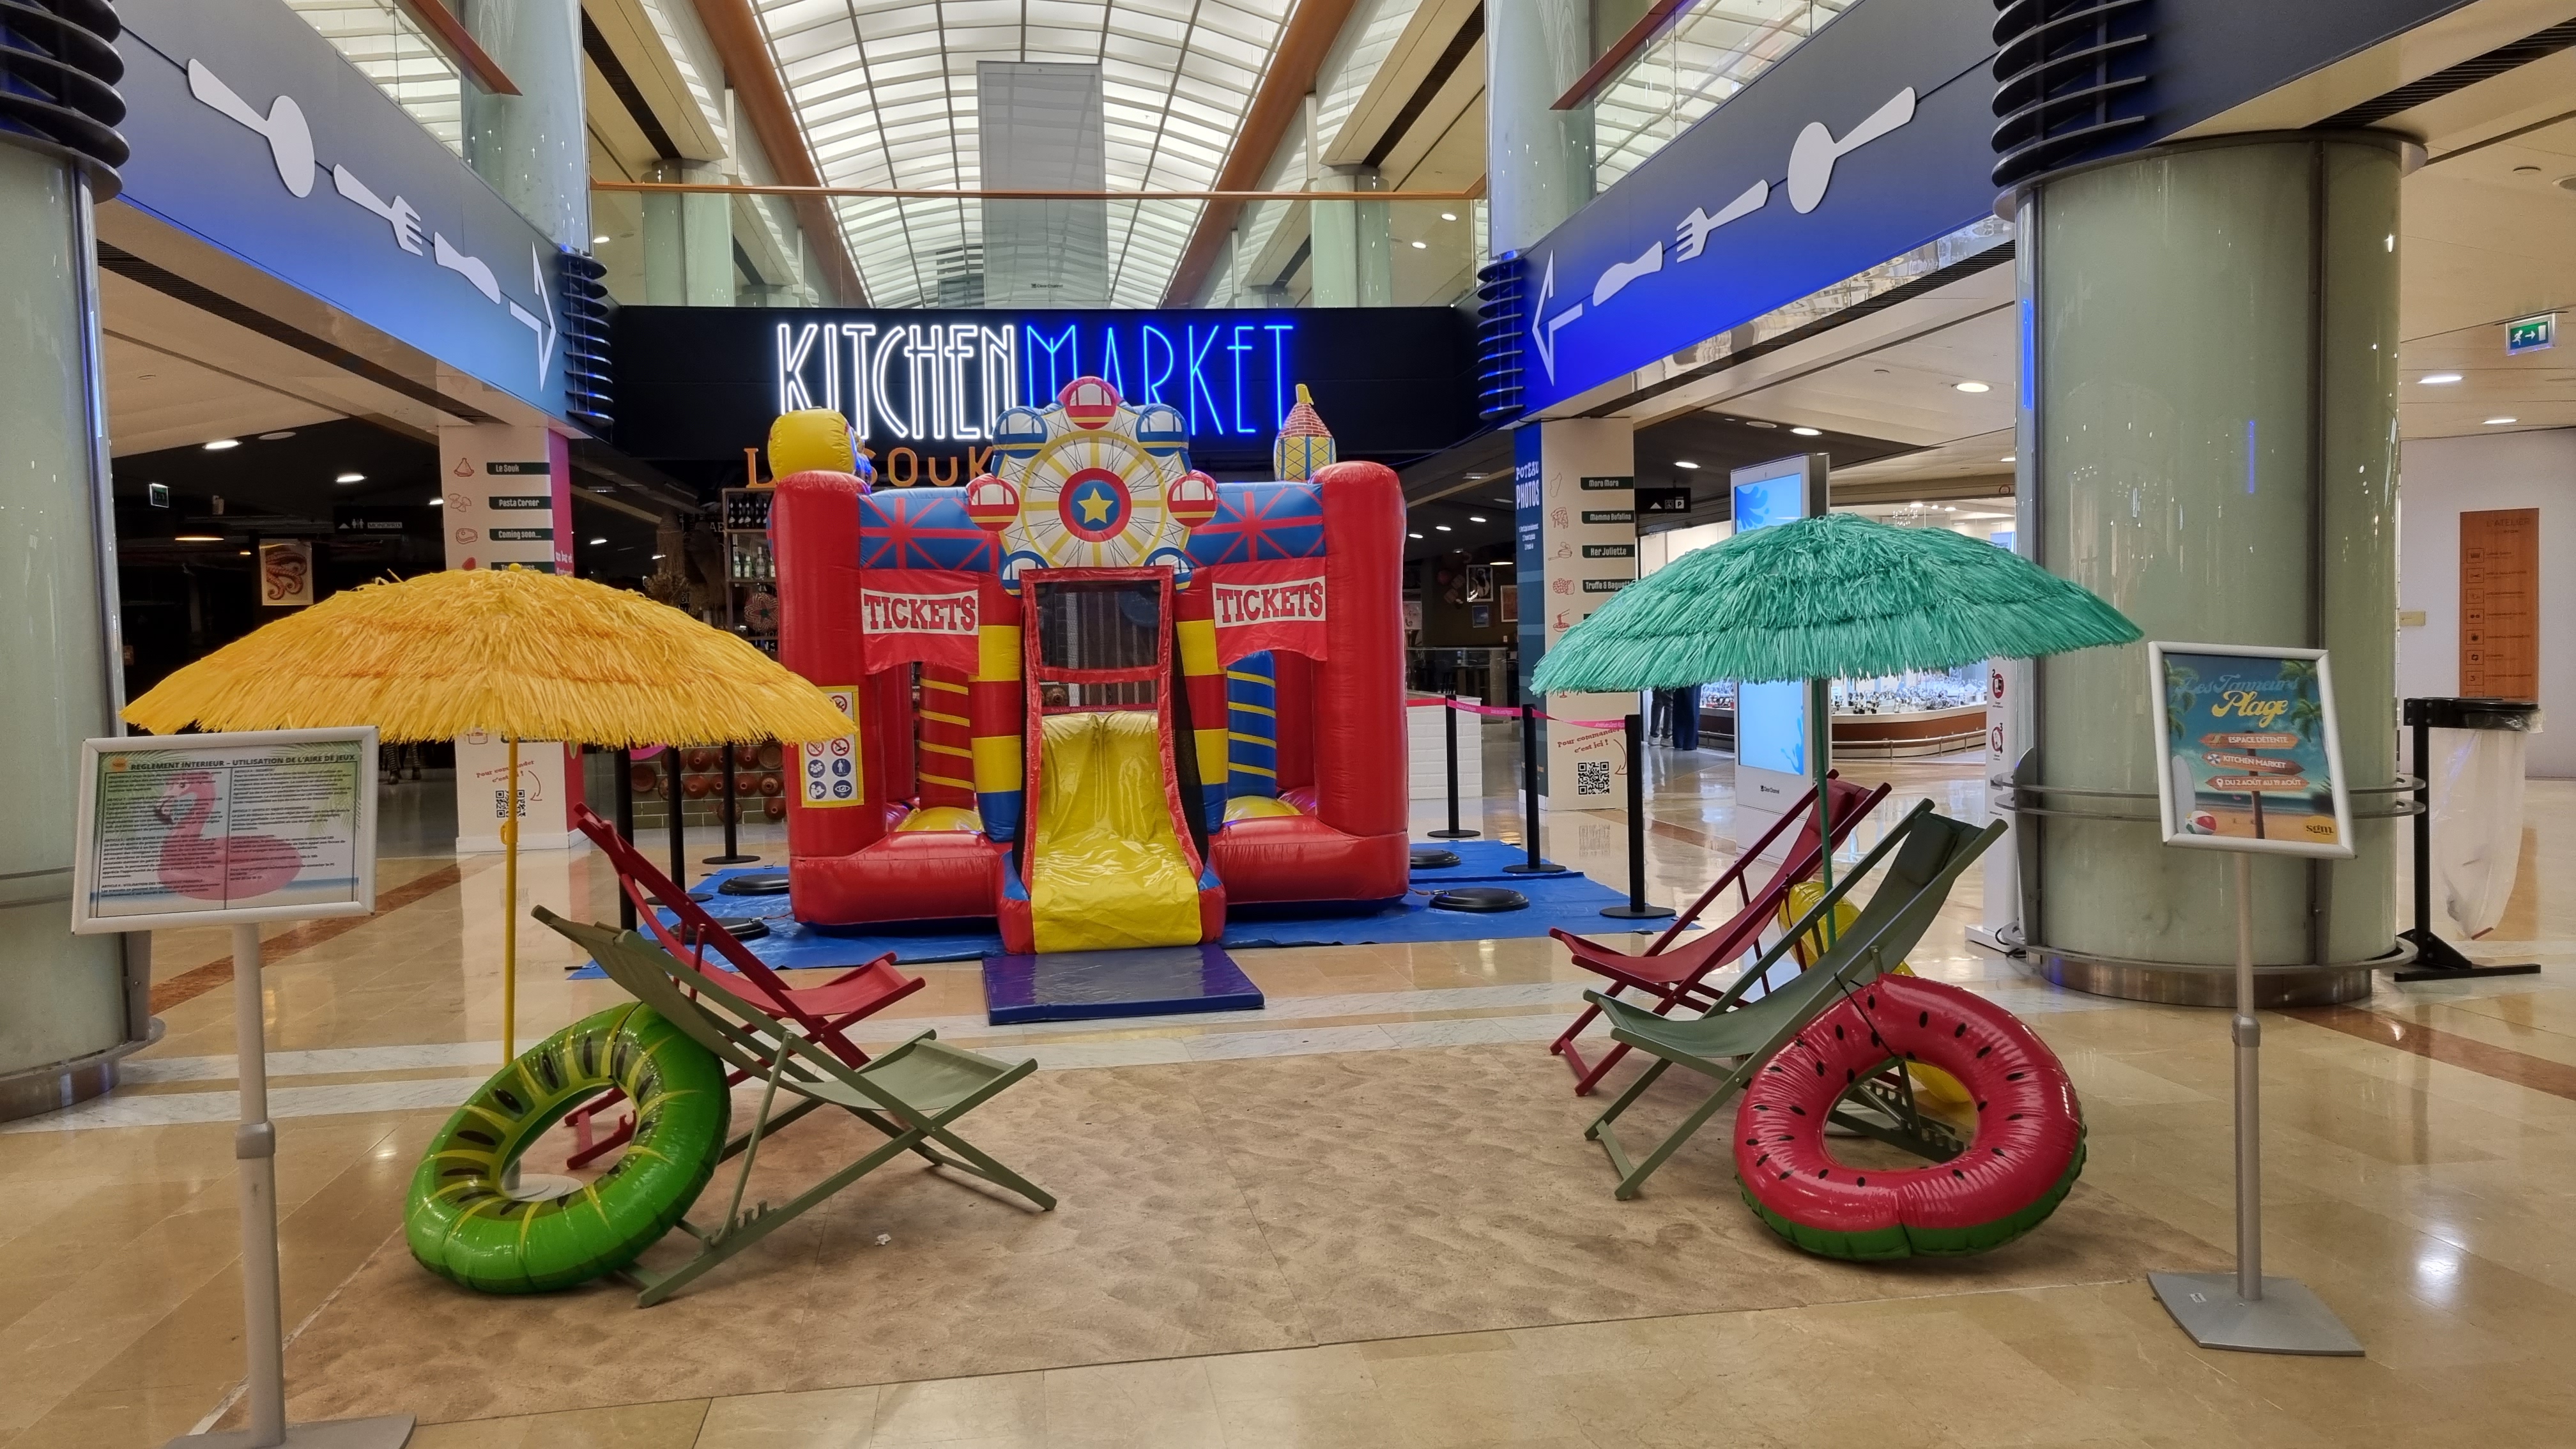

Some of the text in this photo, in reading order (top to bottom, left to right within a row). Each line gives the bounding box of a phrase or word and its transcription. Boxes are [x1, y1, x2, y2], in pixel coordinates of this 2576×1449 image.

[777, 323, 1294, 440] KITCHEN MARKET
[1516, 461, 1539, 480] POTEAU
[1516, 479, 1540, 510] PHOTOS
[498, 530, 521, 539] Coming
[1602, 547, 1627, 556] Juliette
[1585, 581, 1602, 590] Truffe
[1216, 582, 1323, 622] TICKETS
[864, 594, 976, 631] TICKETS
[2175, 674, 2299, 694] Les Tanneurs
[2211, 690, 2288, 728] Plage
[1558, 739, 1575, 748] Pour
[1593, 740, 1604, 748] ici
[131, 762, 181, 770] REGLEMENT
[2223, 755, 2287, 769] KITCHEN MARKET
[476, 770, 493, 778] Pour
[2281, 778, 2301, 786] AOÛT
